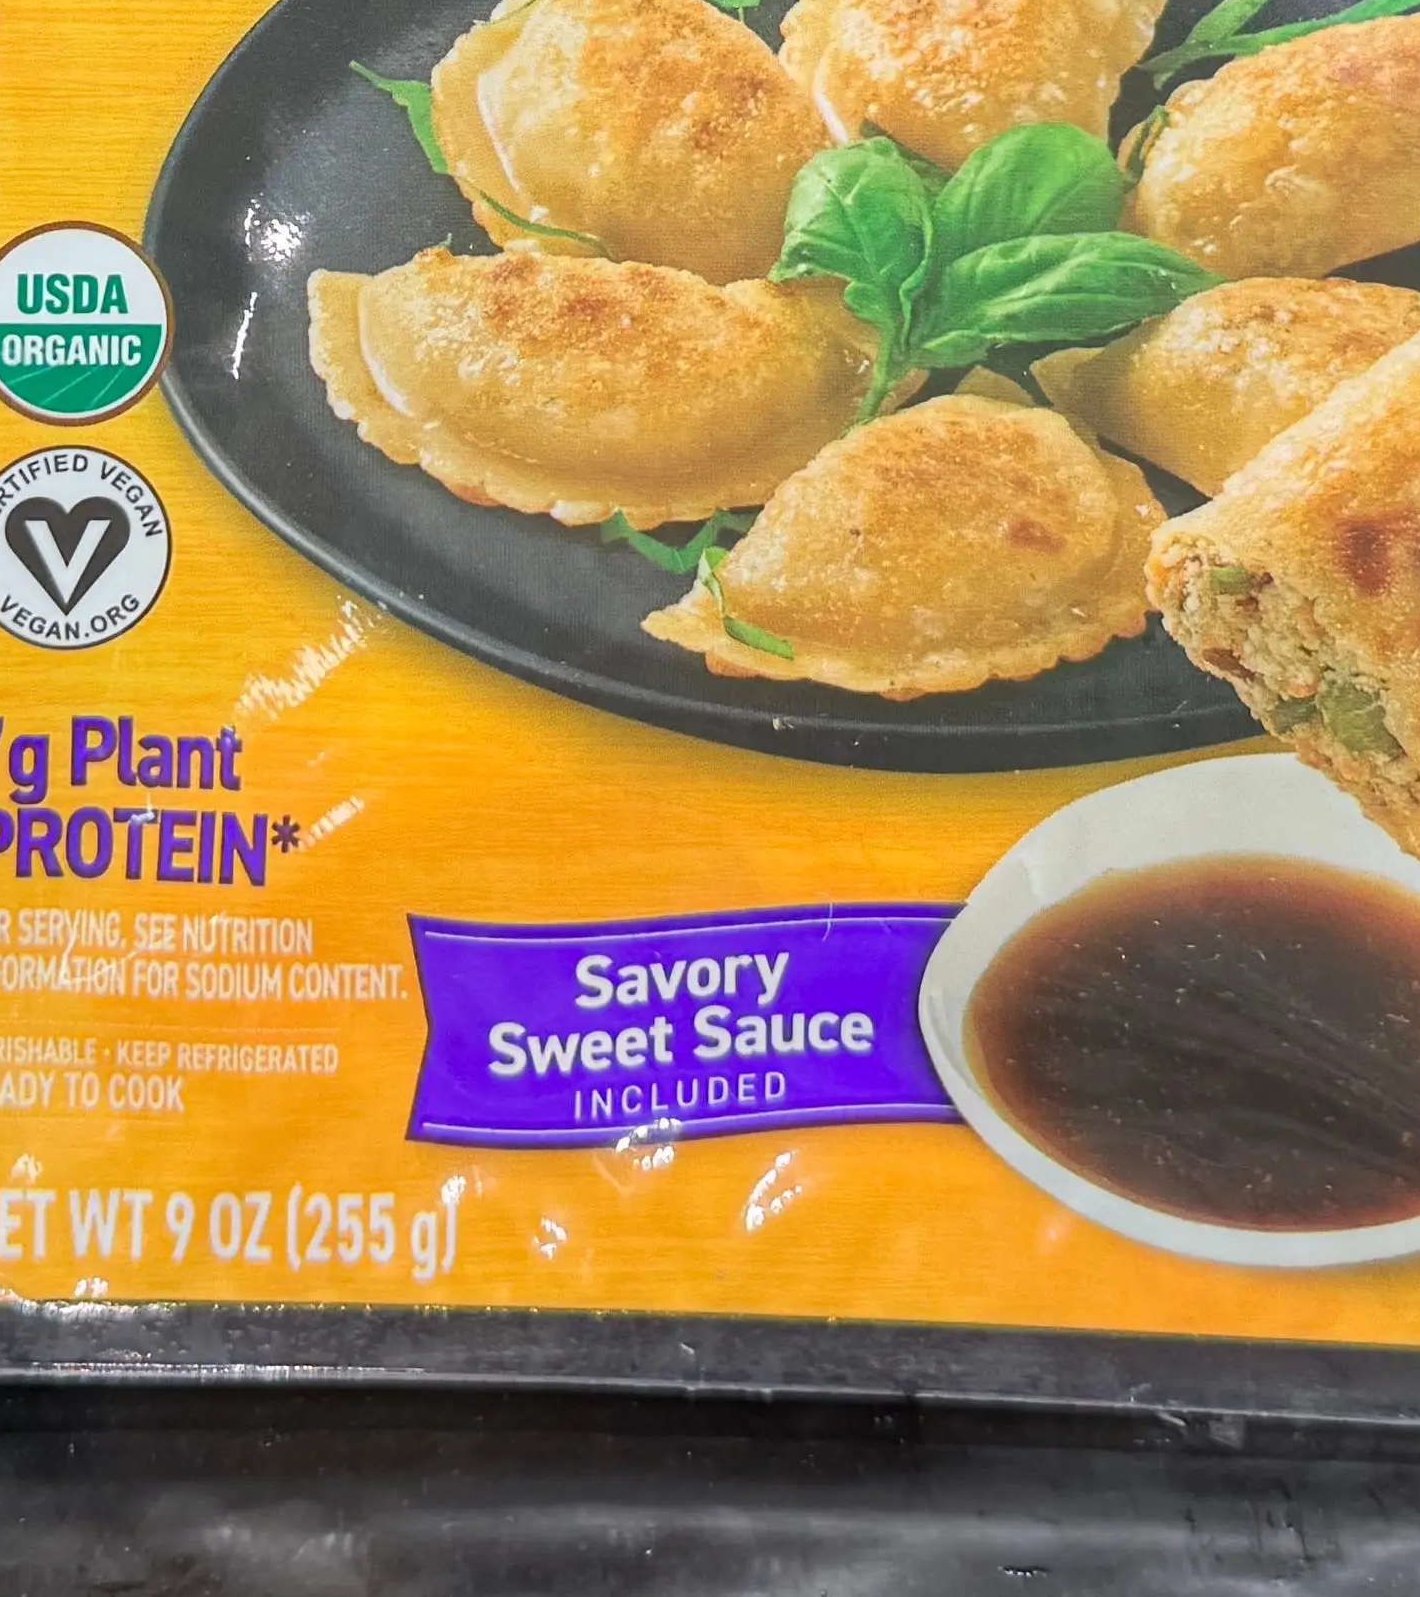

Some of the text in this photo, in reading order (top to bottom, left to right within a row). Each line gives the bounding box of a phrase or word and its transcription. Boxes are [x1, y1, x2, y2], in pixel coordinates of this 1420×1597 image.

[17, 273, 129, 315] USDA
[2, 334, 142, 367] ORGANIC
[98, 461, 164, 538] VEGAN
[0, 592, 141, 641] VEGAN.ORG
[70, 715, 242, 791] Plant
[132, 911, 177, 952] SEE
[182, 913, 313, 956] NUTRITION
[132, 960, 179, 998] FOR
[185, 962, 282, 1001] SODIUM
[287, 963, 409, 1001] CONTENT.
[574, 951, 791, 1010] Savory
[117, 1042, 172, 1069] KEEP
[177, 1044, 341, 1075] REFRIGERATED
[487, 1005, 876, 1077] Sweet Sauce
[65, 1072, 101, 1110] TO
[108, 1074, 186, 1113] COOK
[573, 1070, 788, 1121] INCLUDED
[68, 1188, 155, 1262] WT
[164, 1192, 196, 1261] 9
[207, 1190, 273, 1264] OZ
[285, 1185, 397, 1273] (255
